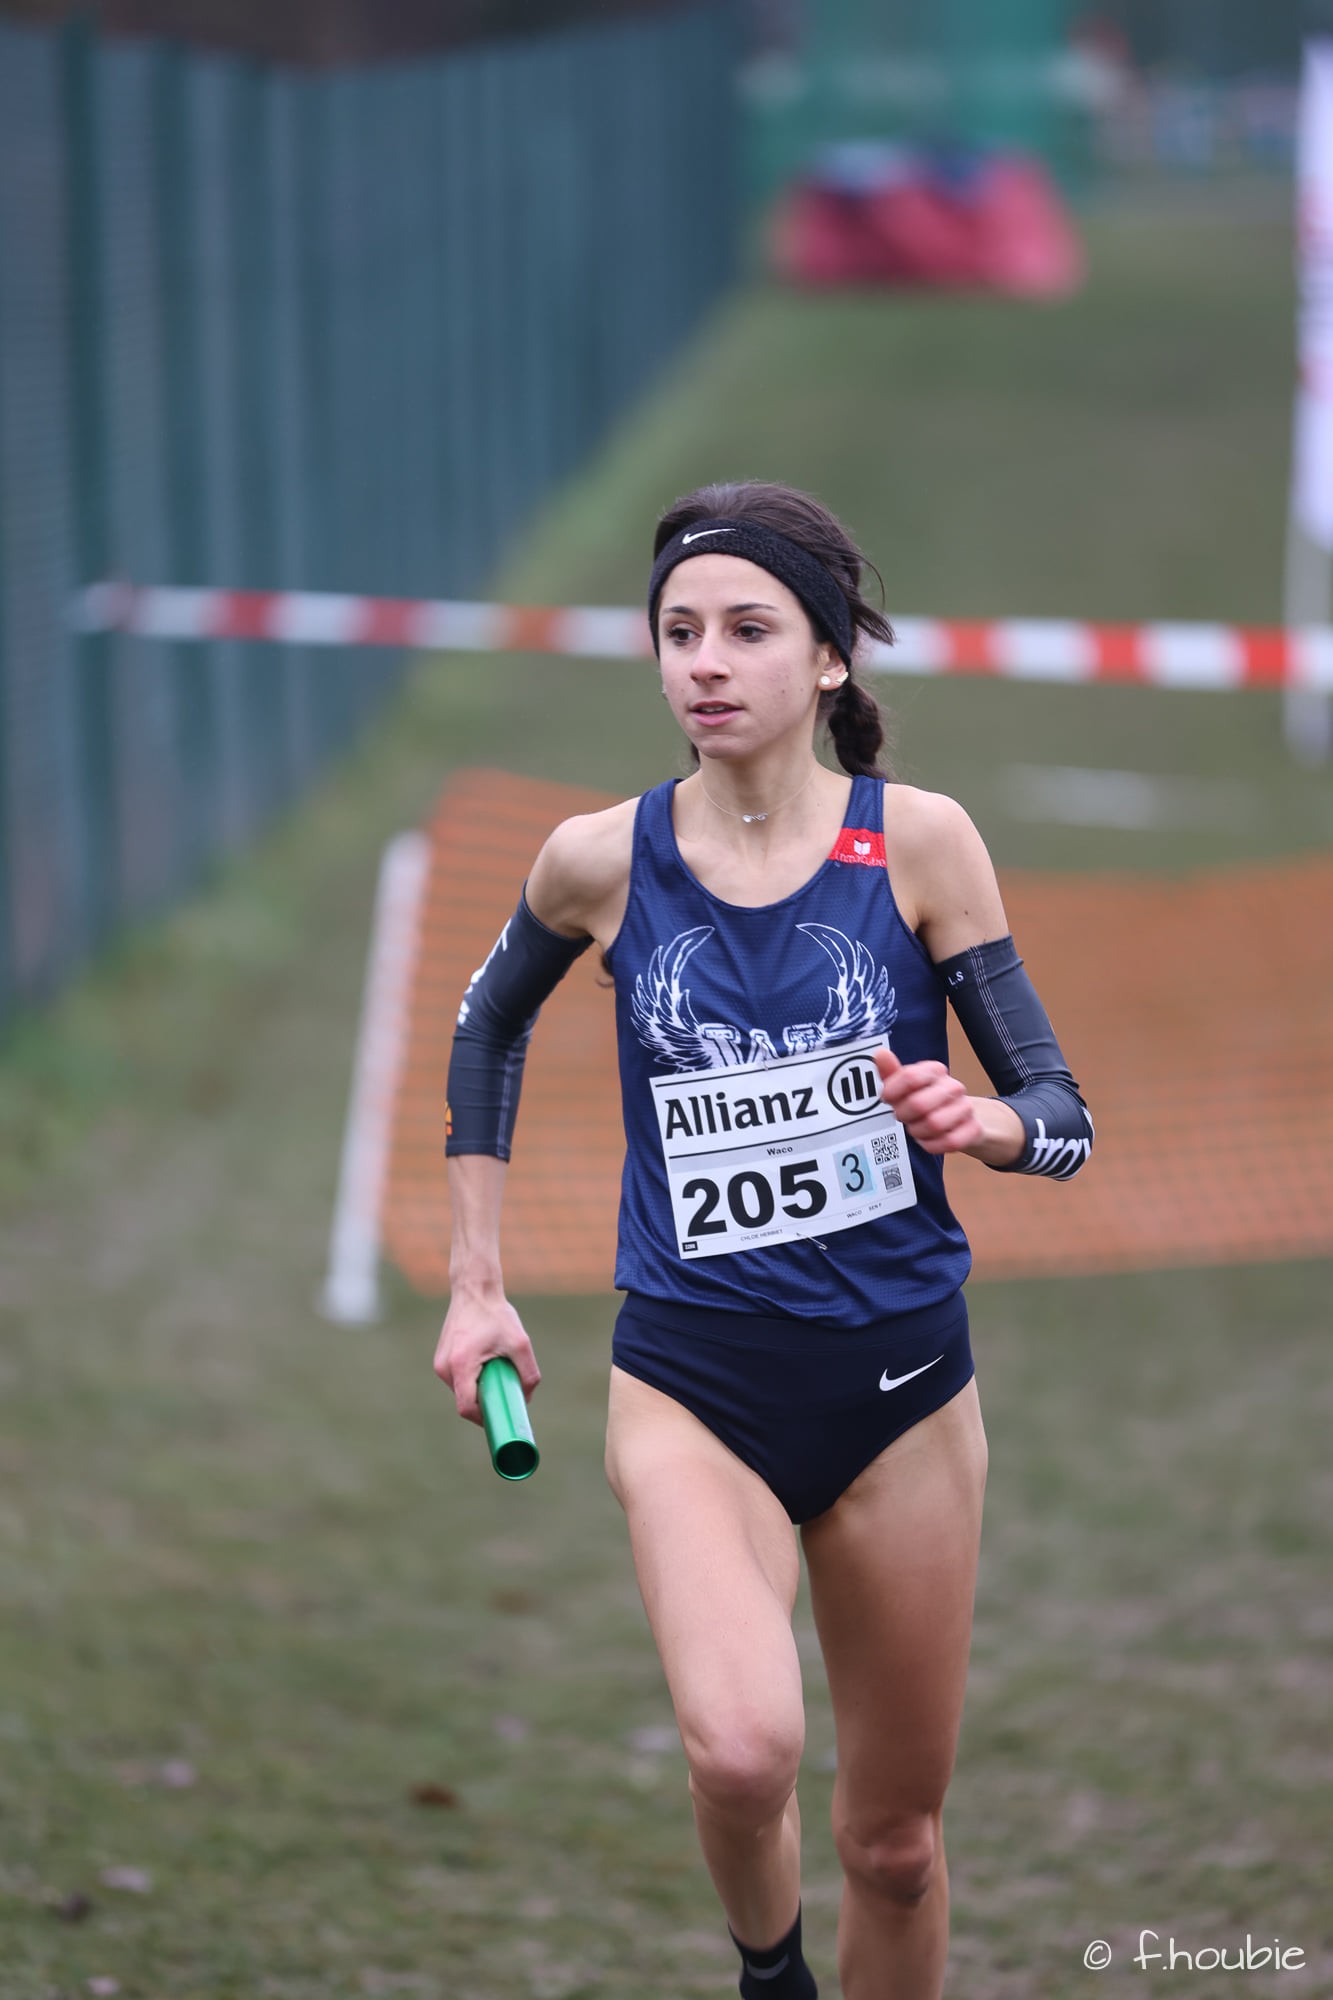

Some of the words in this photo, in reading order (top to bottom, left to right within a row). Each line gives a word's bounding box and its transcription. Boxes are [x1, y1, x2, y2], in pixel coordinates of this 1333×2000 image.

[665, 1086, 819, 1140] Allianz
[766, 1145, 793, 1156] Waco
[841, 1153, 865, 1192] 3
[682, 1159, 828, 1237] 205
